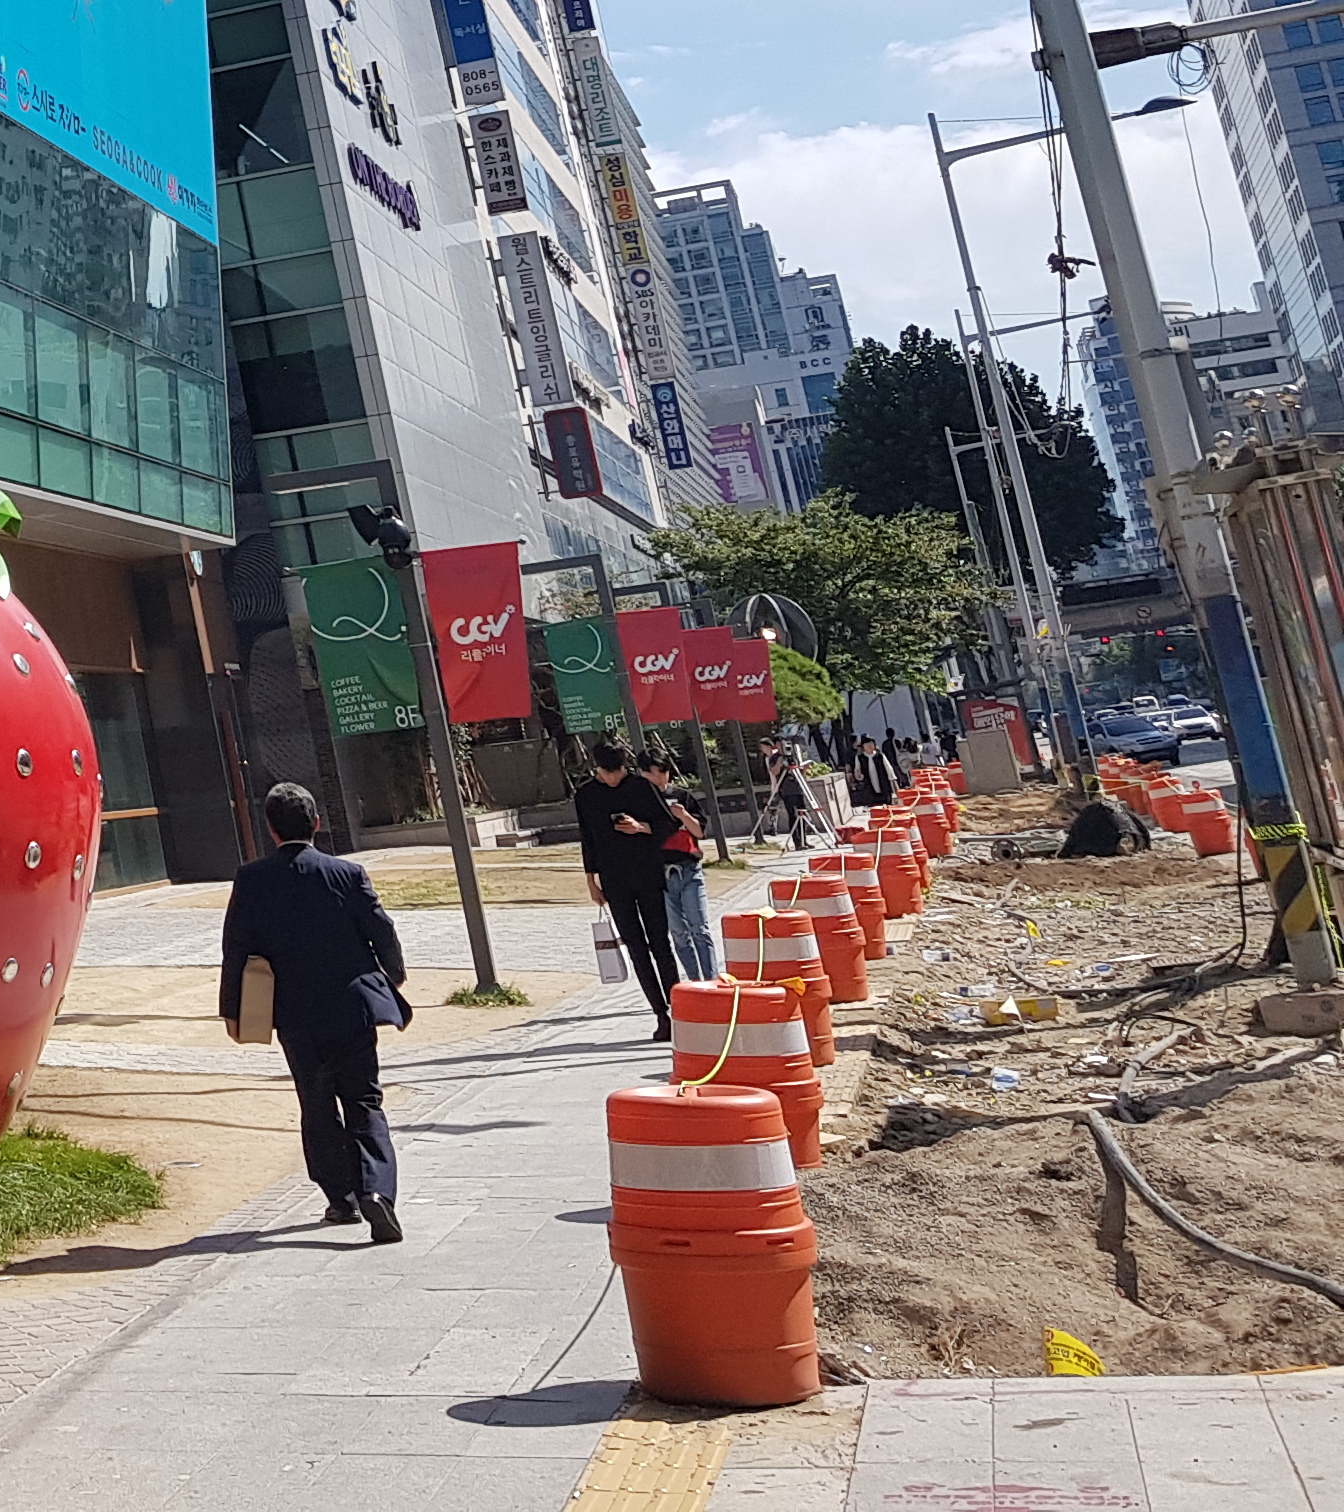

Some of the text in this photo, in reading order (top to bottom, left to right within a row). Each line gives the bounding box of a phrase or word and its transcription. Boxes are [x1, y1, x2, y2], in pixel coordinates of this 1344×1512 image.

[465, 82, 500, 97] 0565
[582, 56, 616, 138] 대명리조트
[32, 84, 56, 122] 스시로
[92, 124, 163, 193] SEOGA&COOK
[634, 288, 655, 299] SBS
[639, 299, 663, 349] 아카데미
[799, 356, 833, 370] BCC
[450, 610, 513, 645] CGV
[461, 643, 507, 662] 리클이너
[634, 651, 678, 674] CGV
[695, 663, 730, 682] CGV
[330, 675, 362, 688] COFFEE
[333, 685, 363, 697] BAKERY
[335, 694, 376, 707] COCKTAIL
[336, 704, 360, 715] PIZZA
[369, 700, 389, 711] BEER
[338, 712, 375, 725] GALLERY
[394, 705, 418, 727] 8F
[604, 714, 622, 730] 8F
[341, 722, 376, 734] FLOWER
